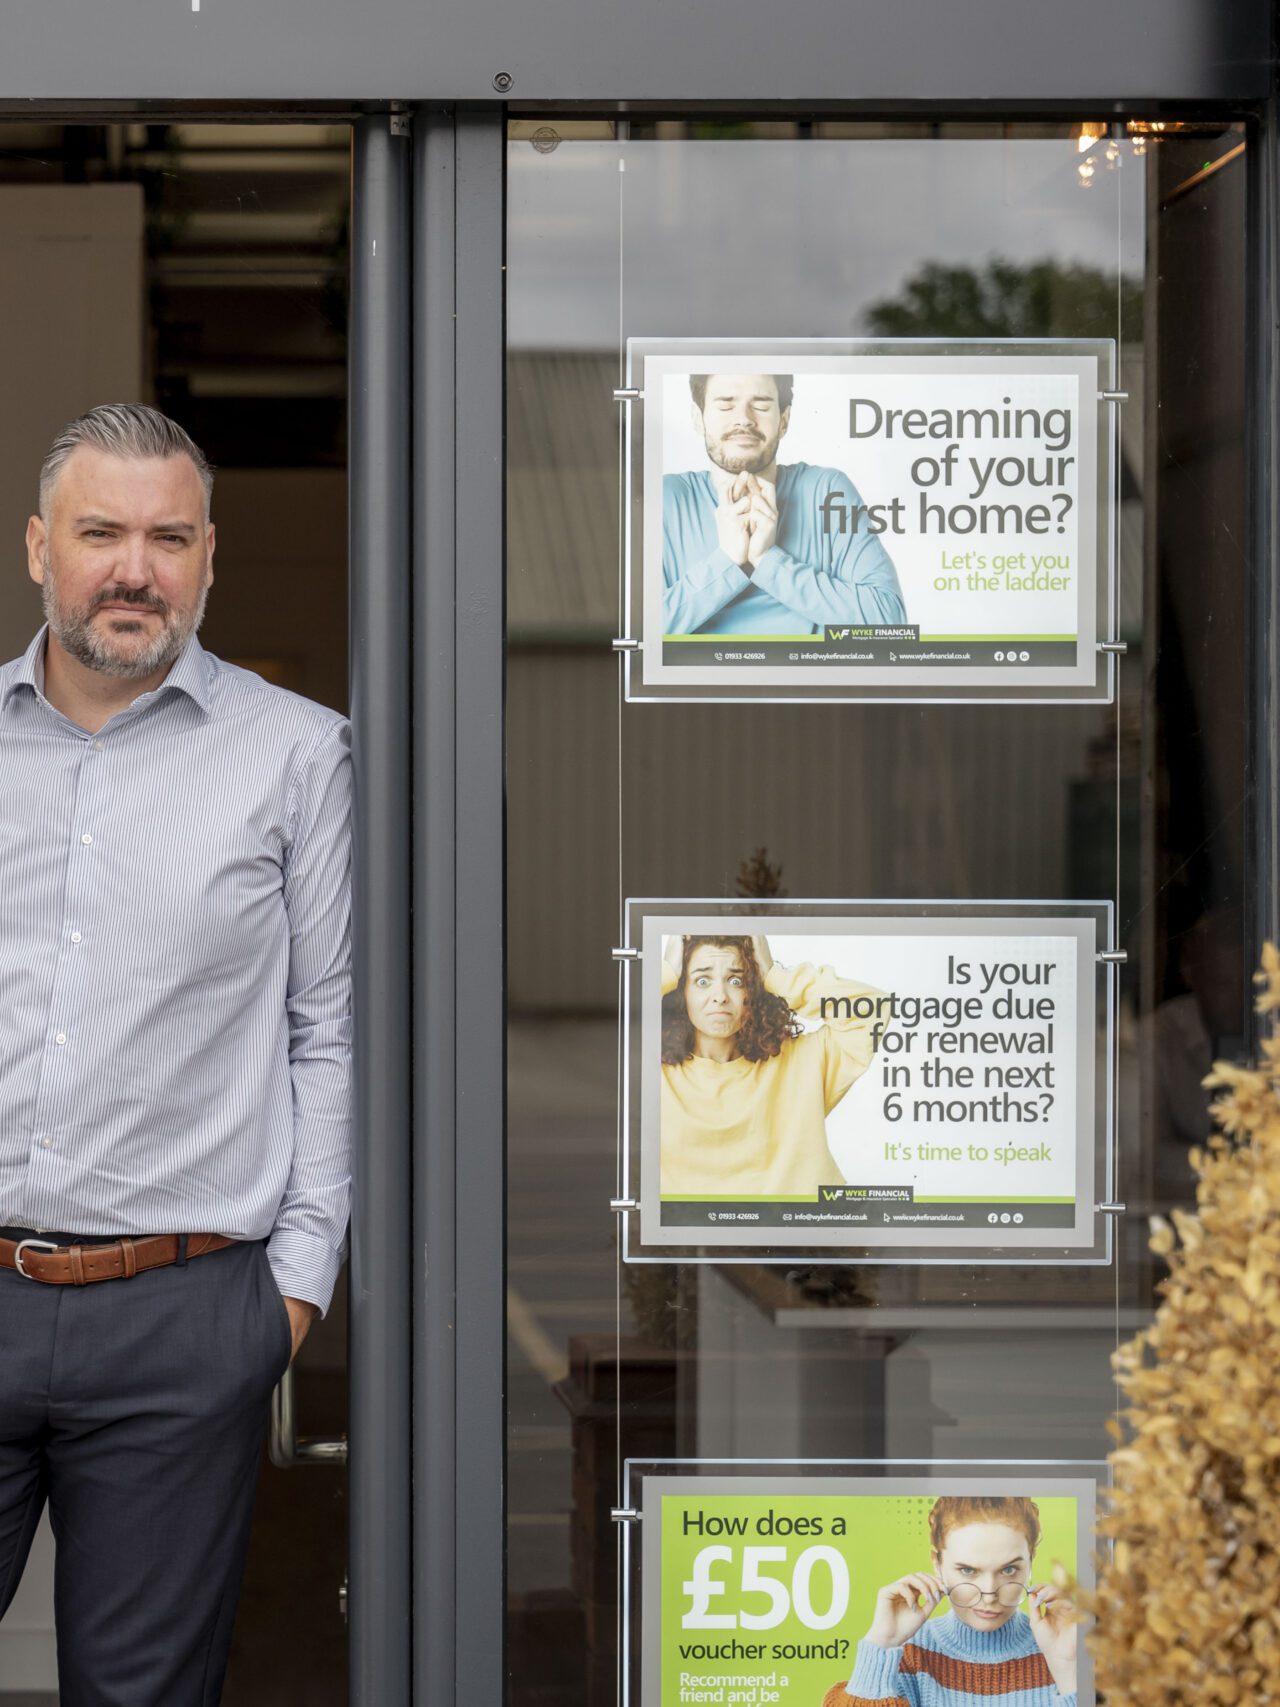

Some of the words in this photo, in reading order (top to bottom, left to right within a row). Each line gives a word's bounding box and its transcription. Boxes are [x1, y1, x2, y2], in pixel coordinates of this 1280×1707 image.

[849, 396, 1072, 450] Dreaming
[911, 443, 958, 487] of
[969, 456, 1075, 499] your
[819, 491, 906, 535] first
[919, 492, 1073, 535] home?
[941, 551, 986, 571] Let's
[991, 554, 1026, 577] get
[1031, 556, 1071, 577] you
[933, 575, 960, 592] on
[966, 571, 1000, 592] the
[1005, 570, 1072, 592] ladder
[800, 652, 874, 662] info@wykefinancial.co.uk
[899, 652, 971, 662] www.wykefinancial.co.uk
[948, 955, 972, 986] Is
[979, 962, 1057, 993] your
[819, 993, 983, 1027] mortgage
[991, 990, 1055, 1020] due
[870, 1023, 919, 1054] for
[927, 1023, 1053, 1054] renewal
[882, 1056, 911, 1088] in
[919, 1057, 974, 1089] the
[984, 1061, 1056, 1089] next
[883, 1092, 903, 1123] 6
[913, 1091, 1055, 1123] months?
[884, 1142, 912, 1161] It's
[917, 1142, 962, 1161] time
[967, 1144, 990, 1161] to
[994, 1142, 1052, 1167] speak
[794, 1212, 868, 1222] info@wykefinancial.co.uk
[682, 1510, 748, 1536] How
[756, 1510, 824, 1536] does
[830, 1516, 847, 1536] a
[681, 1545, 851, 1631] £50
[679, 1639, 767, 1660] voucher
[772, 1639, 850, 1660] sound?
[680, 1672, 776, 1687] Recommend
[779, 1675, 790, 1687] a
[680, 1687, 724, 1703] friend
[727, 1687, 757, 1703] and
[760, 1687, 780, 1703] be
